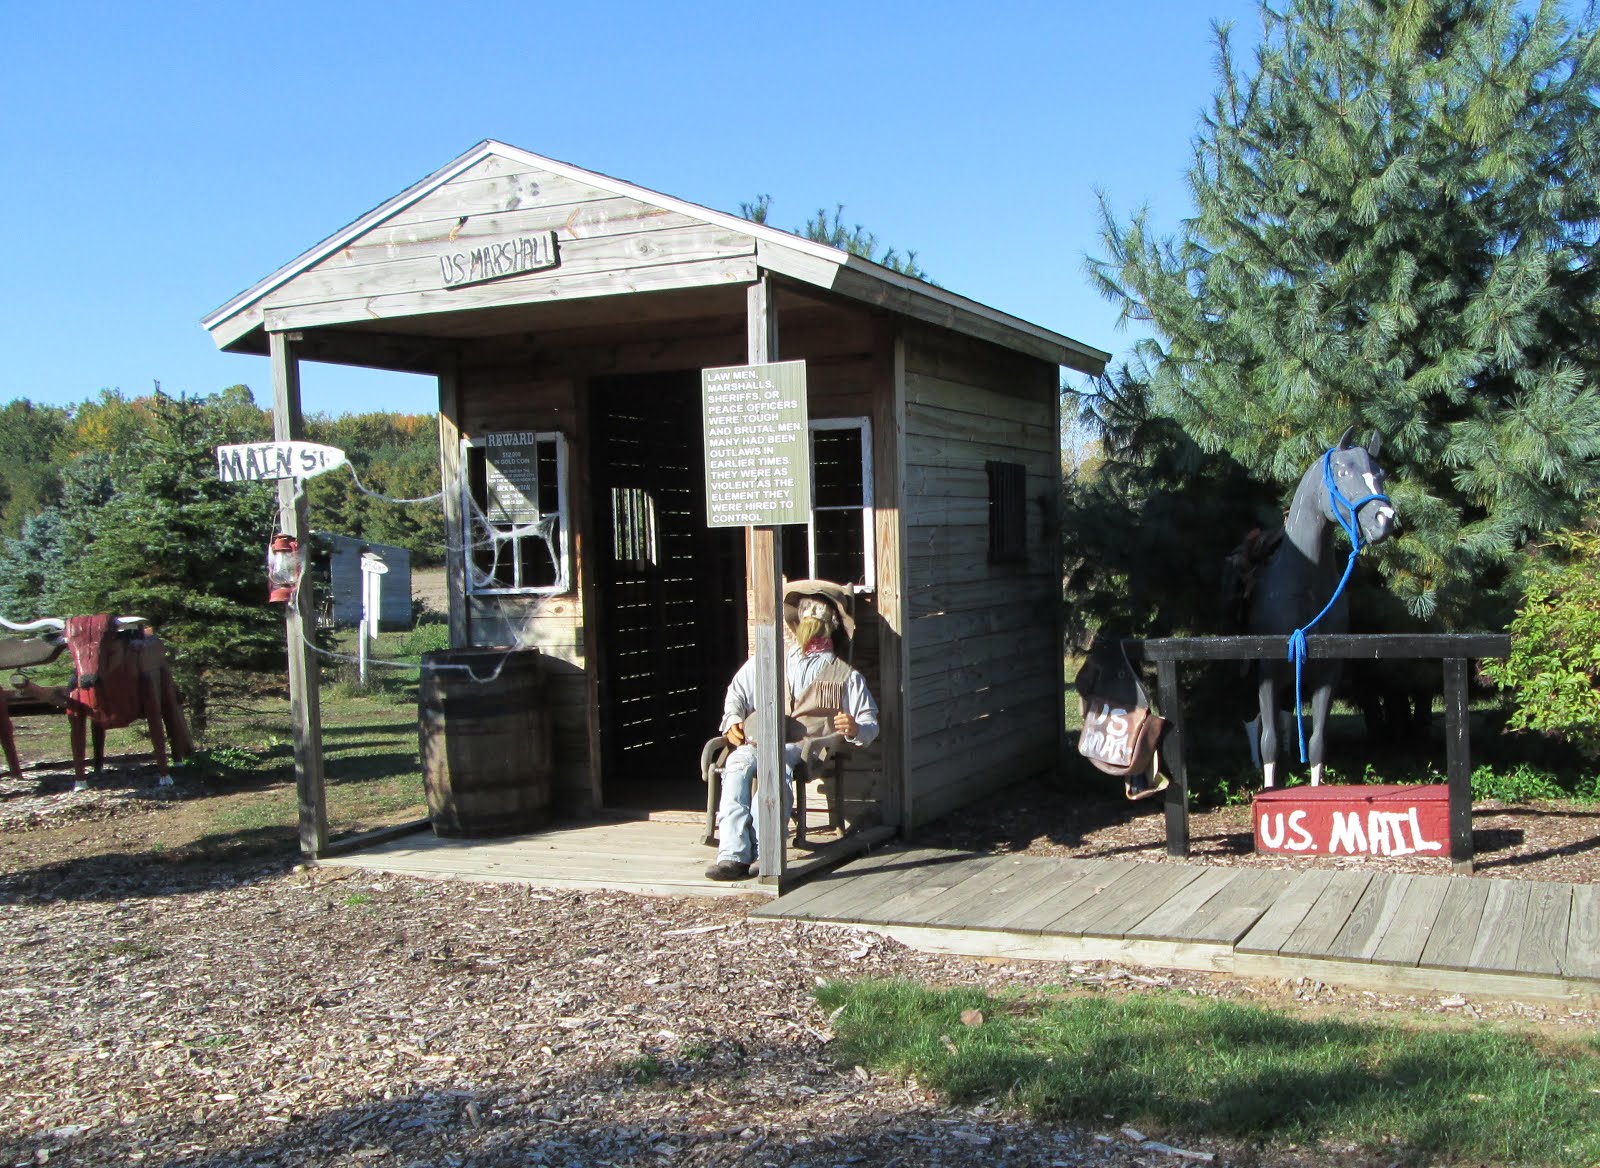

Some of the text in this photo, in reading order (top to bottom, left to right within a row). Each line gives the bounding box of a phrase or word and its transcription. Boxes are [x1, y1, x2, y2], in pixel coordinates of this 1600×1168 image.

[440, 235, 554, 284] US MARSHALL
[707, 370, 759, 381] LAW MEN,
[708, 390, 780, 403] SHERIFFS, OR
[708, 400, 798, 414] PEACE OFFICERS
[709, 413, 779, 425] WERE TOUGH
[709, 422, 803, 436] AND BRUTAL MEN.
[488, 432, 534, 446] REWARD
[709, 434, 795, 447] MANY HAD BEEN
[710, 446, 774, 458] OUTLAWS IN
[221, 446, 292, 481] MAIN
[710, 457, 792, 469] EARLIER TIMES.
[711, 467, 788, 479] THEY WERE AS
[711, 478, 794, 490] VIOLENT AS THE
[711, 489, 790, 501] ELEMENT THEY
[712, 500, 794, 512] WERE HIRED TO
[712, 513, 762, 523] CONTROL
[1260, 807, 1442, 857] U.S. MAIL
